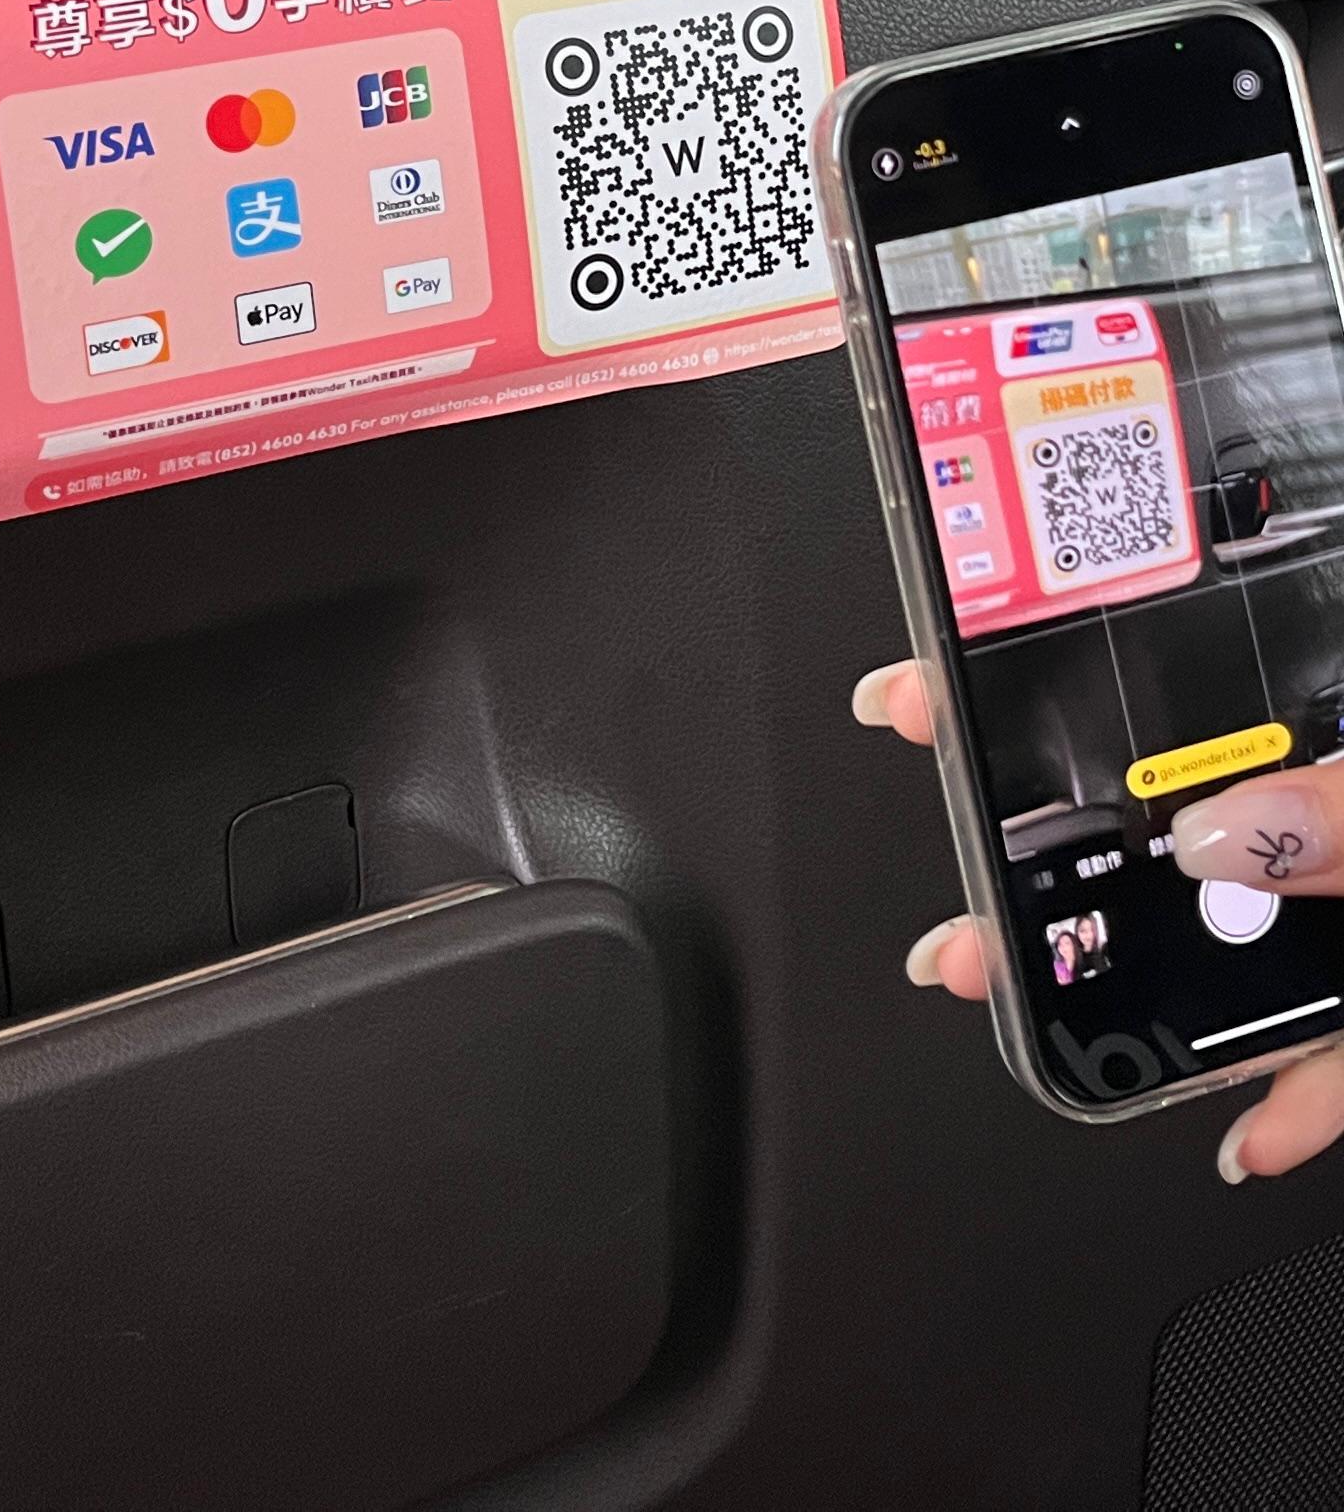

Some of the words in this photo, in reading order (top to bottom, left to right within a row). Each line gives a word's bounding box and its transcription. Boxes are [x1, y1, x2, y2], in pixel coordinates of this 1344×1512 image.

[359, 81, 429, 111] JCB
[43, 121, 155, 170] VISA
[662, 136, 705, 177] W
[377, 199, 412, 212] Diners
[414, 192, 440, 205] Club
[413, 276, 441, 295] Pay
[265, 300, 303, 327] Pay
[89, 331, 158, 357] DISCOVER
[261, 433, 303, 452] 4600
[306, 423, 347, 443] 4630
[351, 417, 377, 433] For
[380, 411, 410, 427] any
[411, 395, 494, 420] assistance,
[496, 380, 545, 406] please
[547, 374, 573, 392] call
[575, 367, 615, 389] (852)
[618, 360, 658, 379] 4600
[662, 353, 699, 372] 4630
